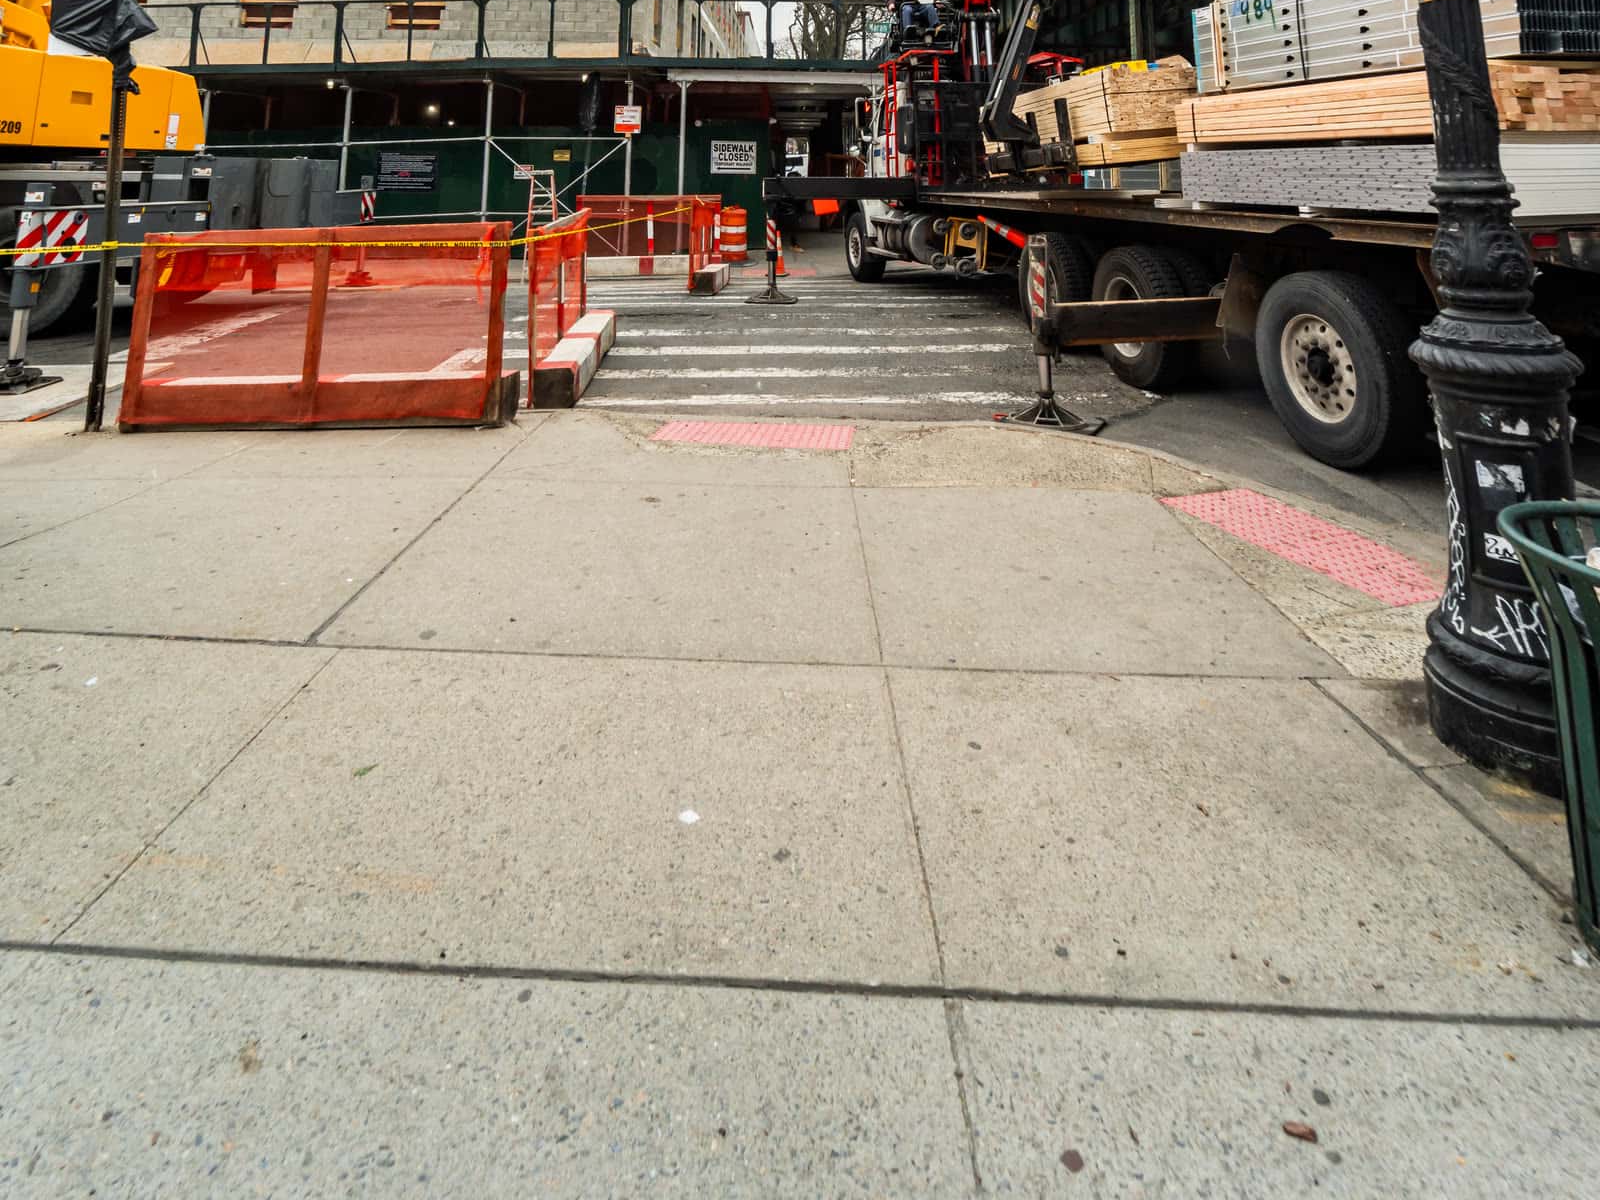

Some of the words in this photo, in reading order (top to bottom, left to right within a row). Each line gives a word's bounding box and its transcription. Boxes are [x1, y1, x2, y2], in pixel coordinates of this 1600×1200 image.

[0, 120, 22, 135] 209
[713, 143, 754, 152] SIDEWALK
[718, 153, 749, 161] CLOSED
